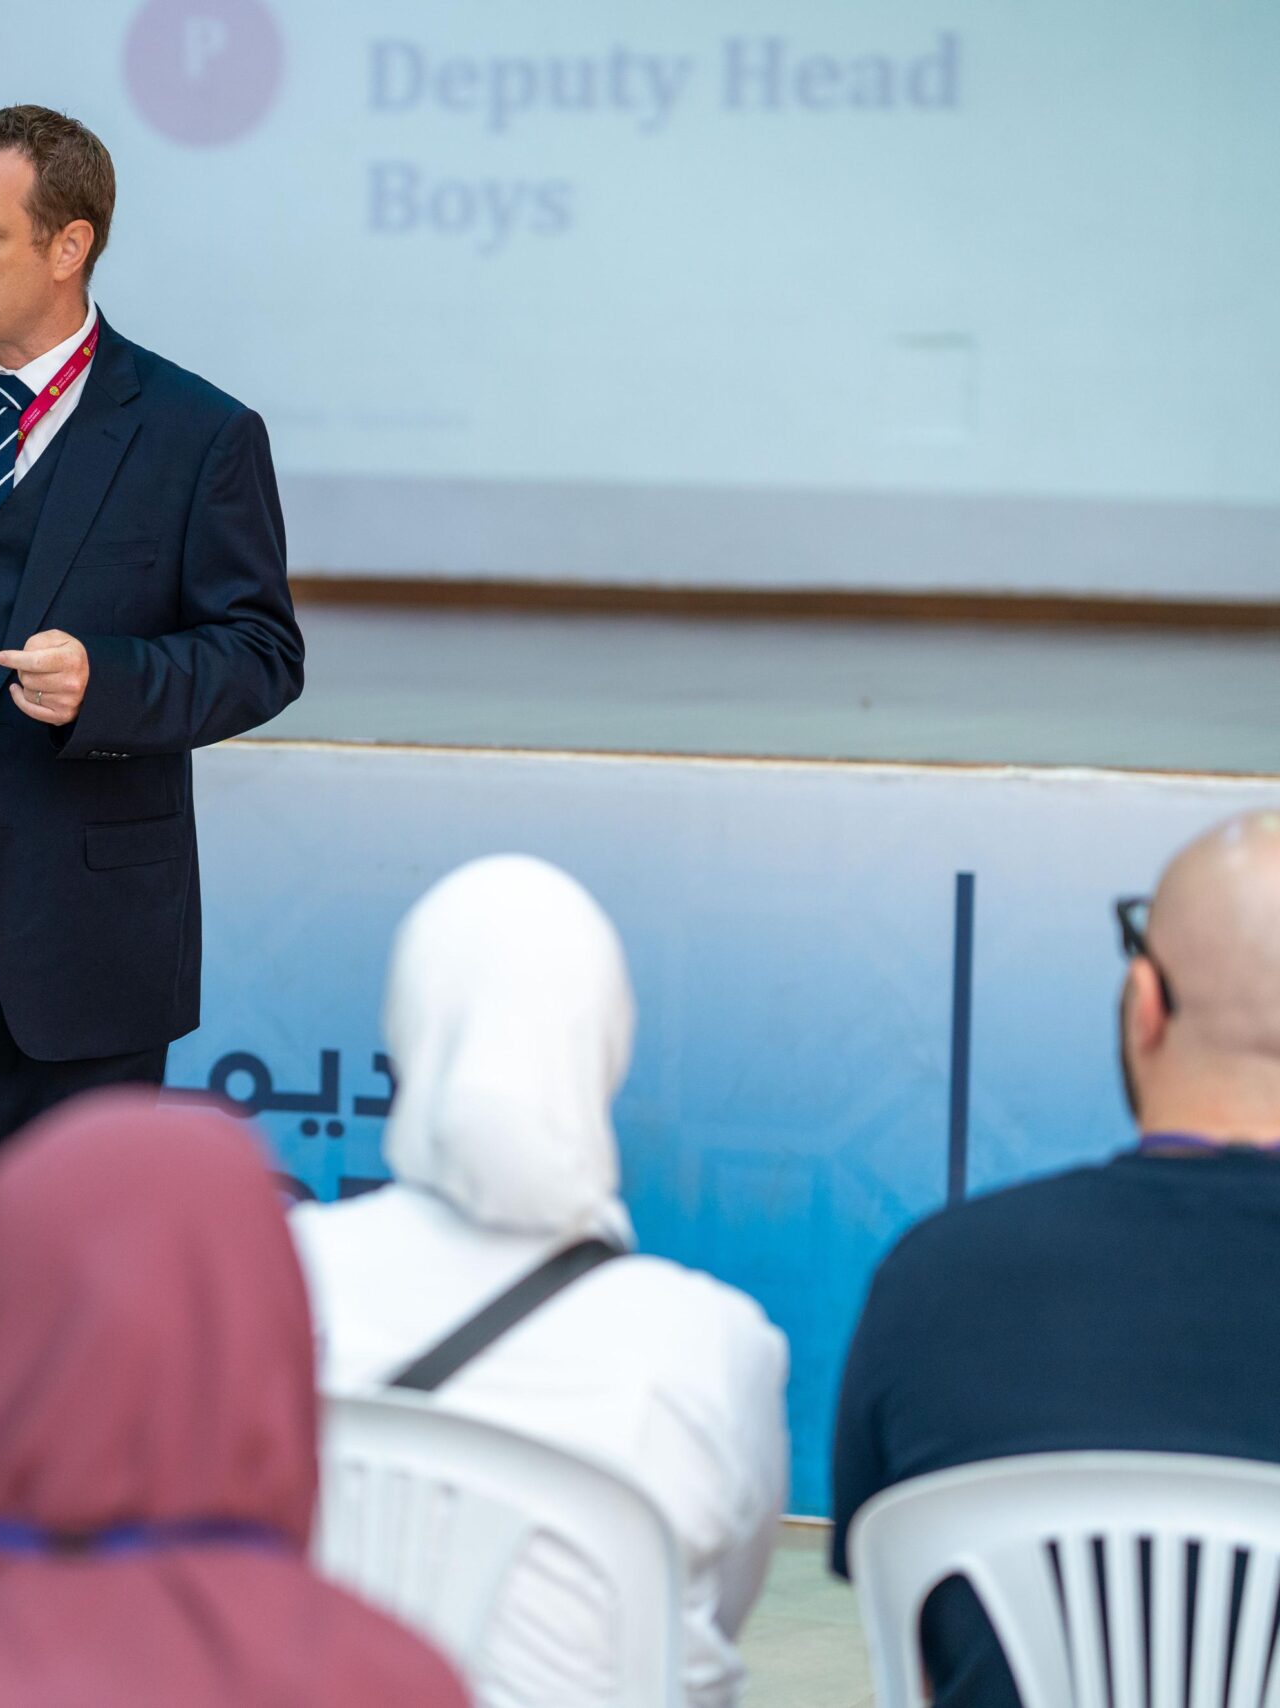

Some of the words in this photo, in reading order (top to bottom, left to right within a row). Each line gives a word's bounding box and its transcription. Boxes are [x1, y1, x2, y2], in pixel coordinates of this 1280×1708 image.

[182, 14, 228, 79] P
[365, 36, 698, 136] Deputy
[720, 31, 961, 113] Head
[366, 159, 577, 258] Boys
